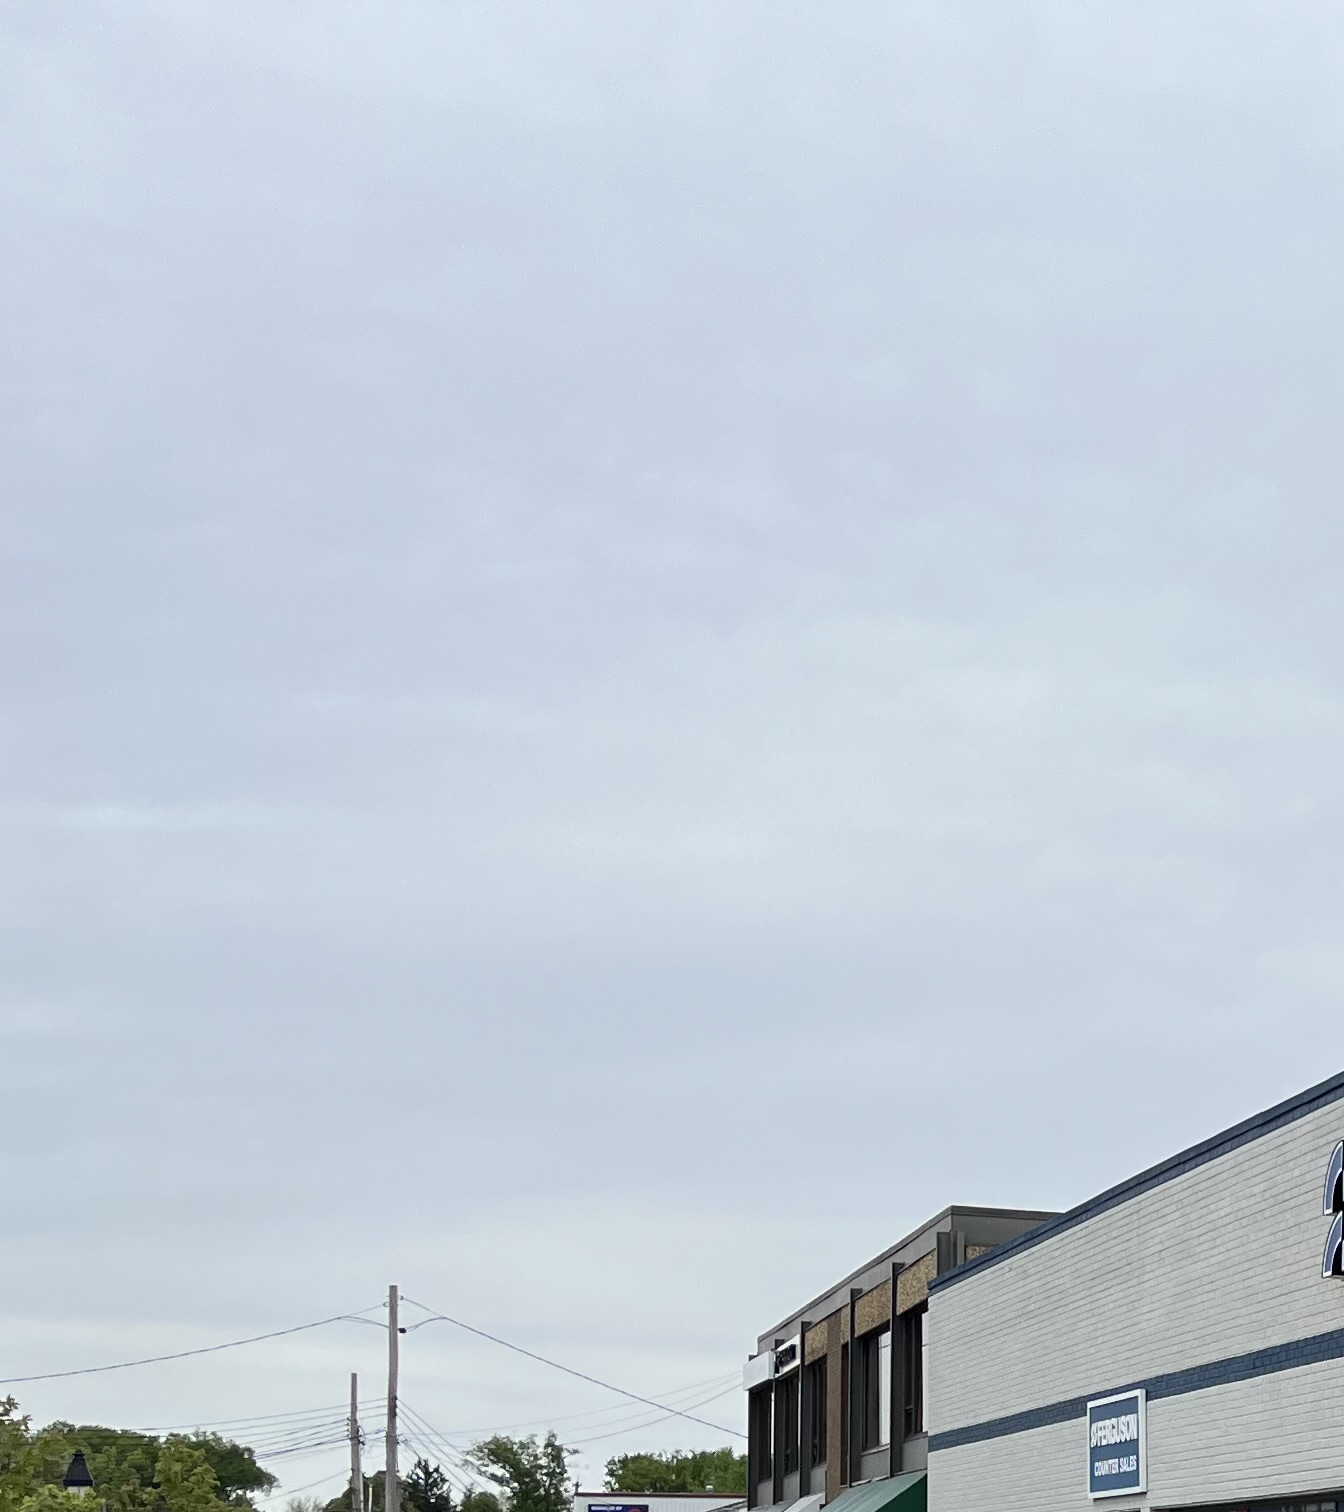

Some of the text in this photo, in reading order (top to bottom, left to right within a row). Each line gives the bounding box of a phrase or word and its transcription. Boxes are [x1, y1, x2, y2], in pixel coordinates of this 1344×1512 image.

[1097, 1413, 1138, 1447] FERGUSON
[1094, 1454, 1137, 1477] COUNTER SALES
